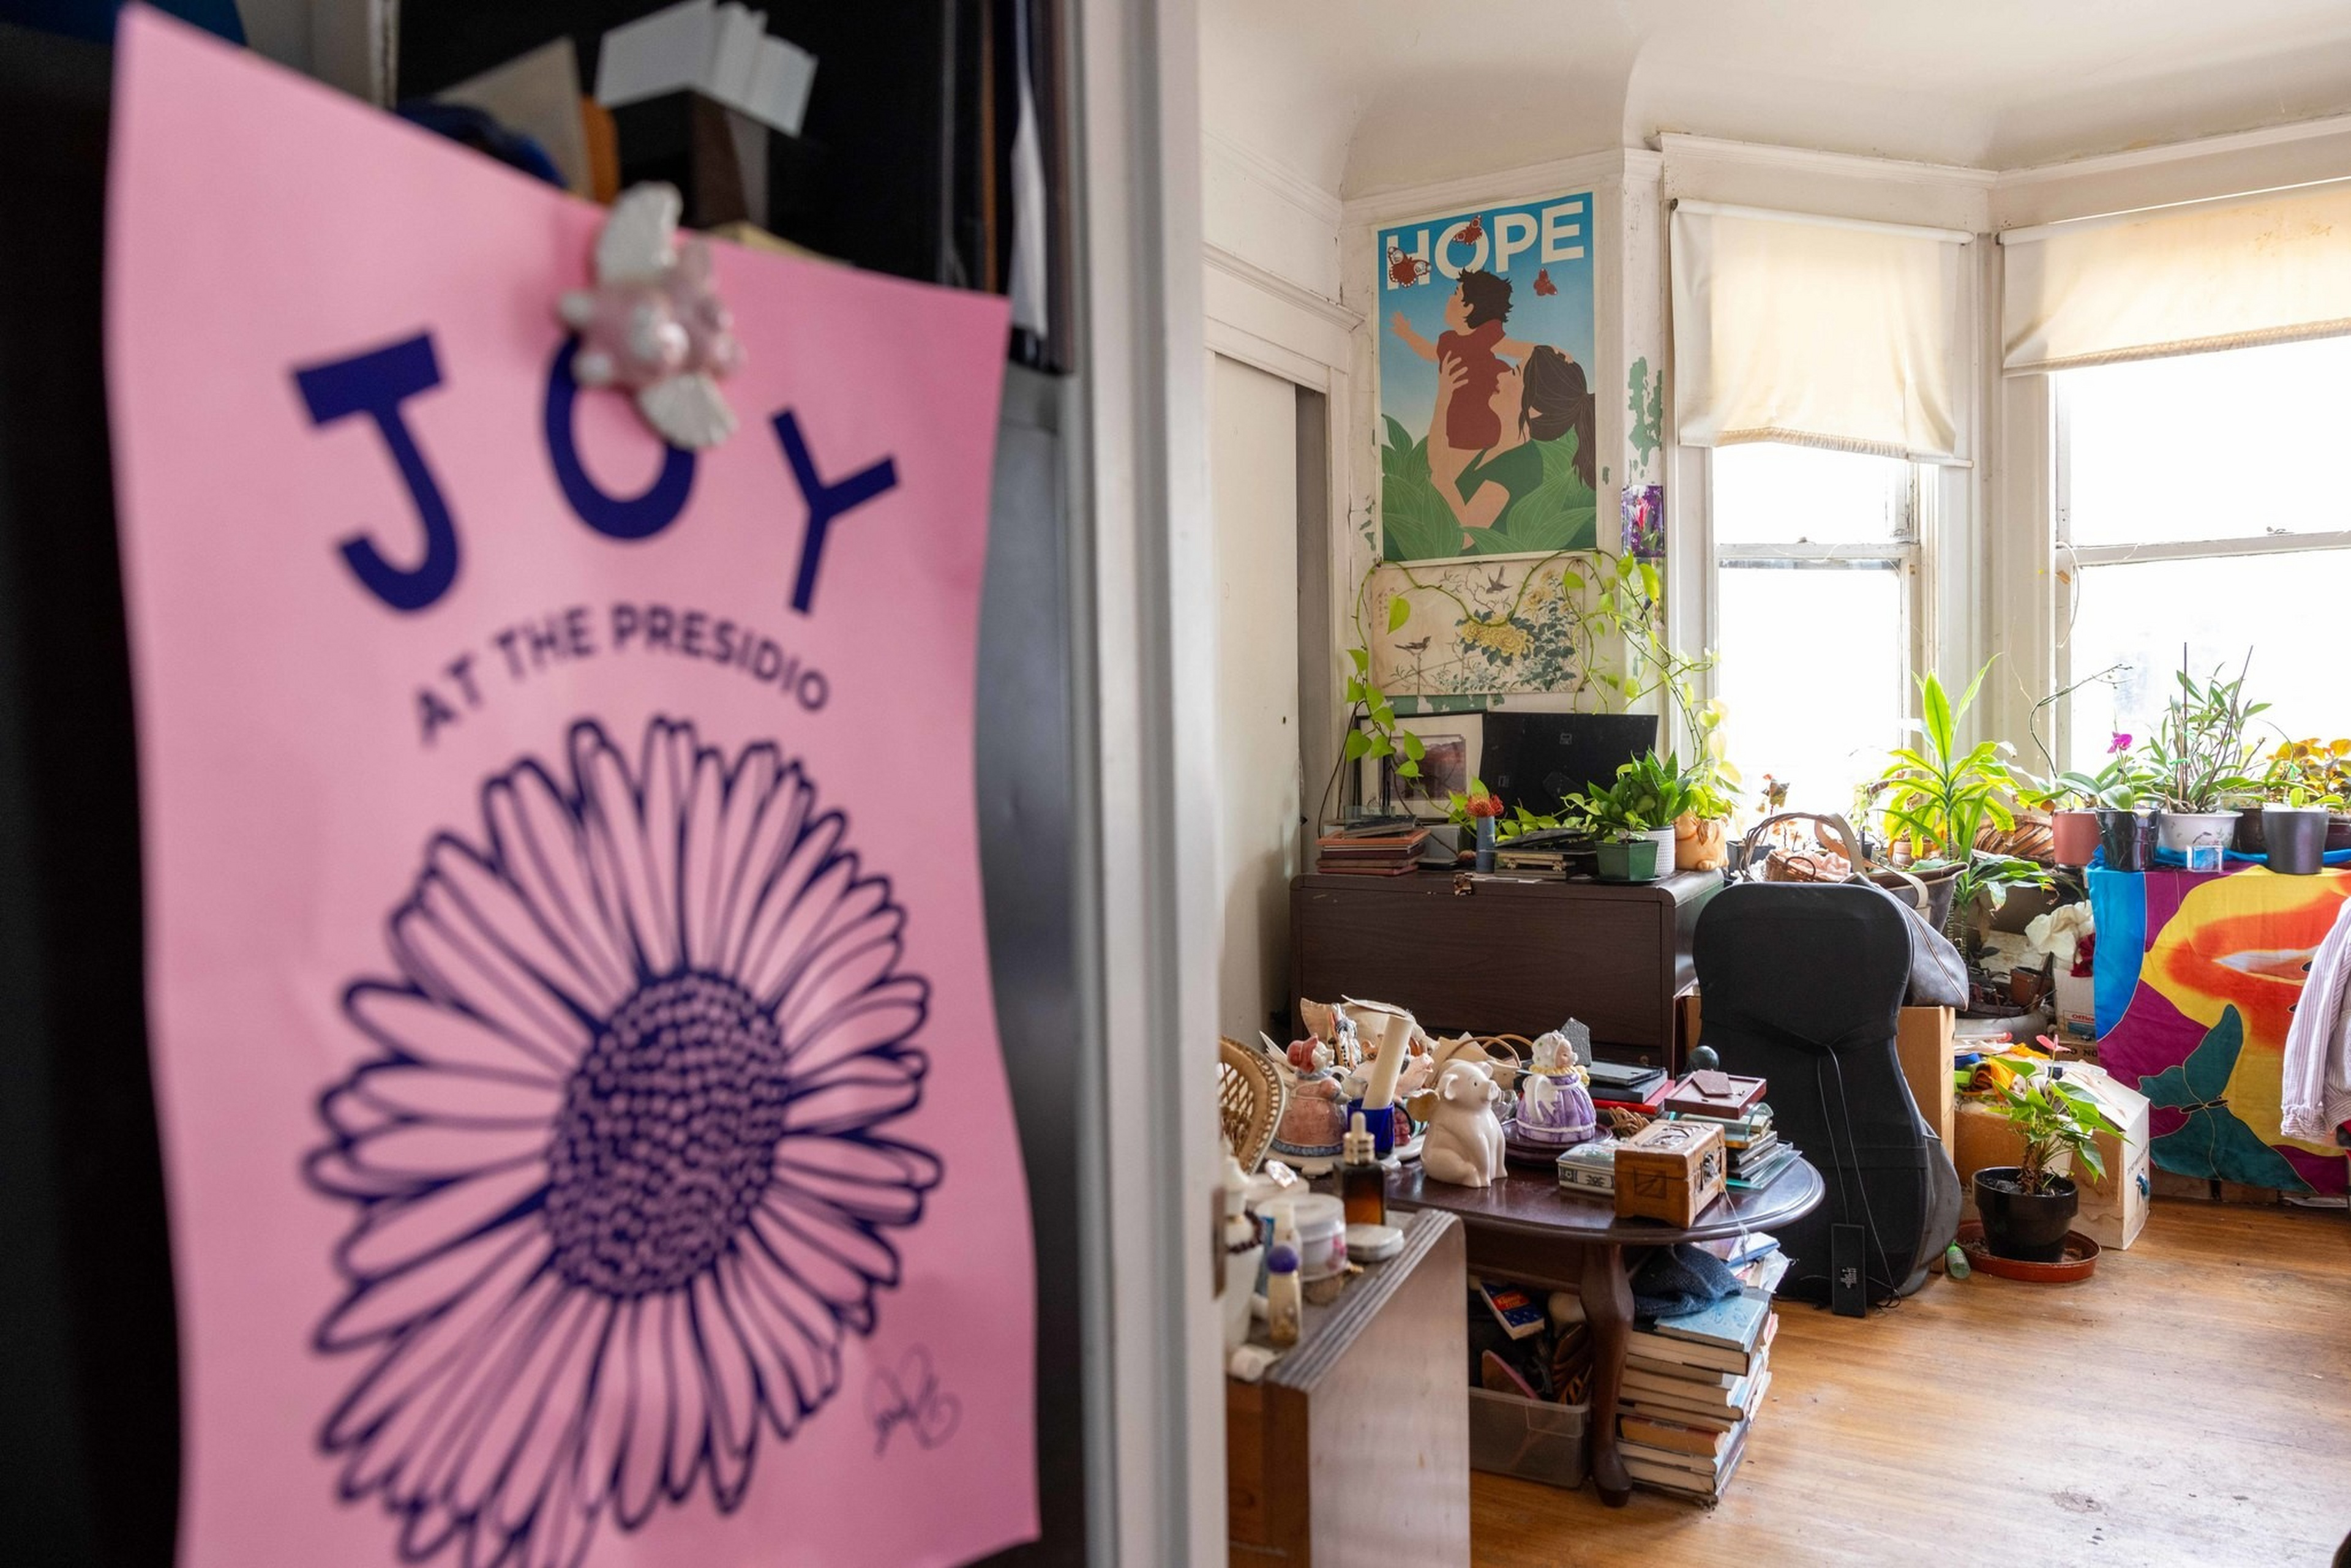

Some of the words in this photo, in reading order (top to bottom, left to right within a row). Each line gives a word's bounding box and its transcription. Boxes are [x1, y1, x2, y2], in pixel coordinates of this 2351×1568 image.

[1386, 200, 1584, 291] HOPE
[291, 327, 901, 616] JOY
[415, 651, 482, 748] AT
[493, 607, 595, 681] THE
[610, 604, 829, 713] PRESIDIO
